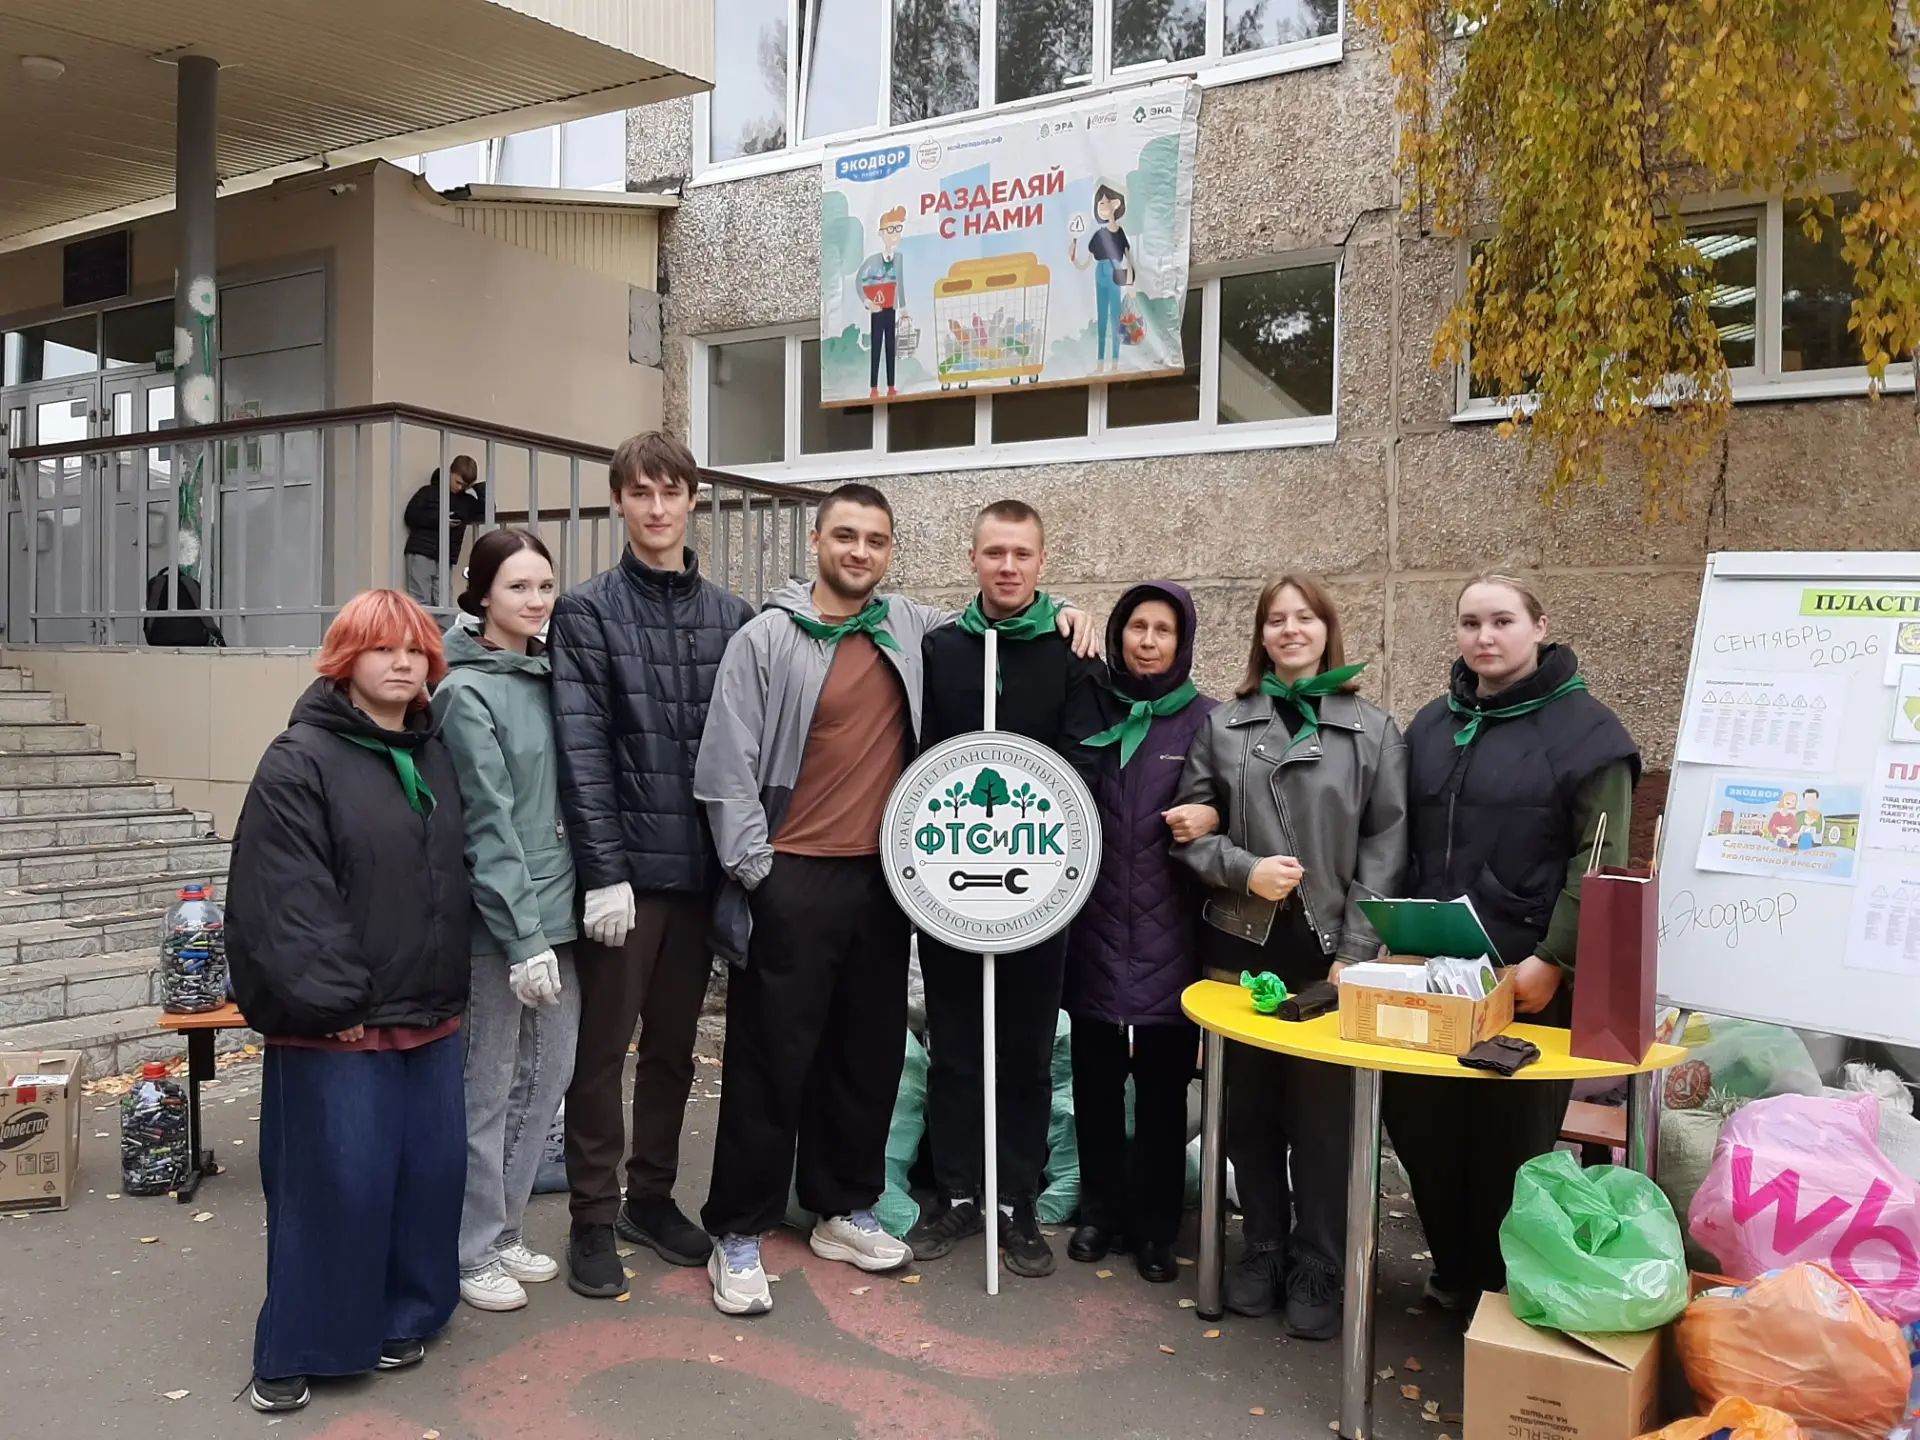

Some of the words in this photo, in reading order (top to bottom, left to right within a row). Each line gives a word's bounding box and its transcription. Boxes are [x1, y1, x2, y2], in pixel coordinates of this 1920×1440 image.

[1150, 106, 1172, 116] ЭКА
[1054, 121, 1074, 131] ЭРА
[840, 150, 906, 174] ЭКОДВОР
[920, 165, 1065, 216] РАЗДЕЛЯЙ
[939, 217, 957, 239] С
[964, 203, 1043, 236] НАМИ
[1713, 625, 1831, 653] СЕНТЯБРЬ
[1810, 635, 1879, 667] 2026
[898, 767, 944, 850] ФАКУЛЬТЕТ
[942, 749, 1061, 790] ТРАНСПОРТНЫХ
[1057, 788, 1082, 850] СИСТЕМ
[1880, 810, 1906, 818] ПАКЕТ
[921, 895, 982, 934] ЛЕСНОГО
[986, 887, 1068, 935] КОМПЛЕКСА
[1405, 996, 1427, 1007] 20
